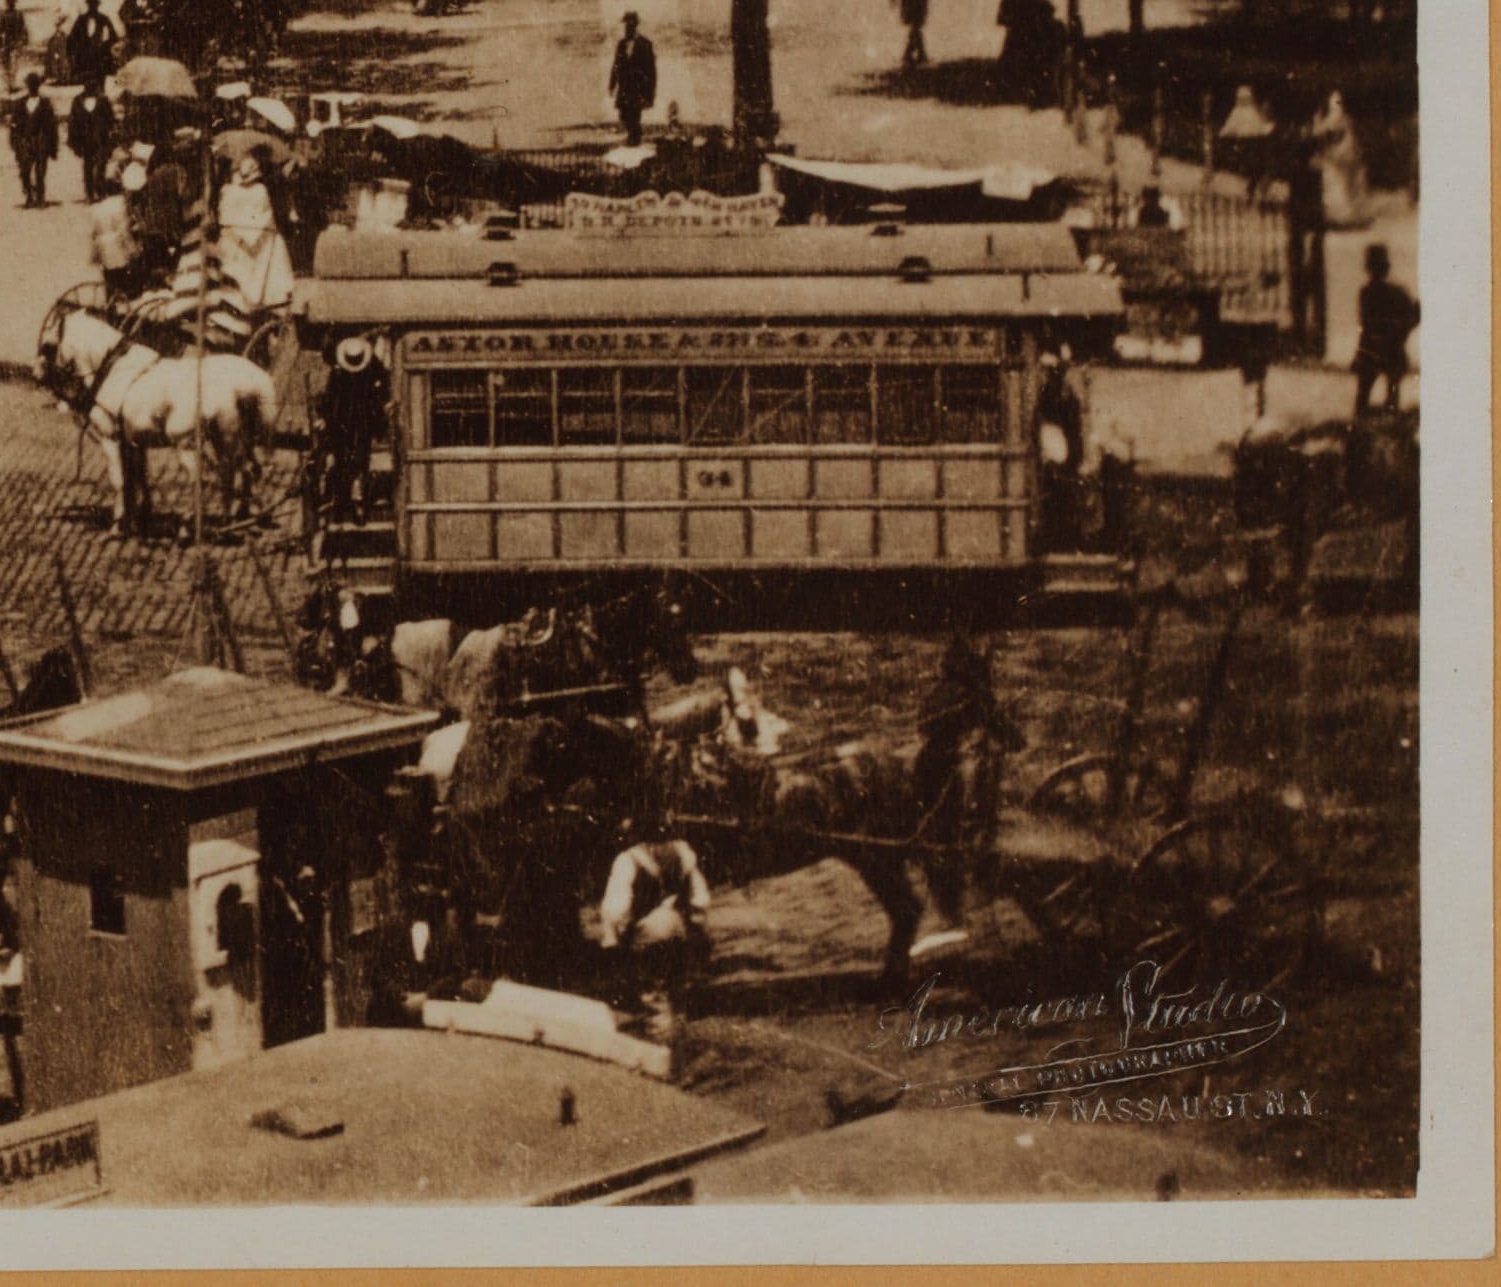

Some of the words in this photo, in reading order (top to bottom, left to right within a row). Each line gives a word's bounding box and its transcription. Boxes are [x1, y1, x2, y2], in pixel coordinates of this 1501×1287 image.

[411, 335, 533, 353] ASTOR
[549, 333, 668, 352] HOUSE
[831, 329, 992, 349] AVENUE
